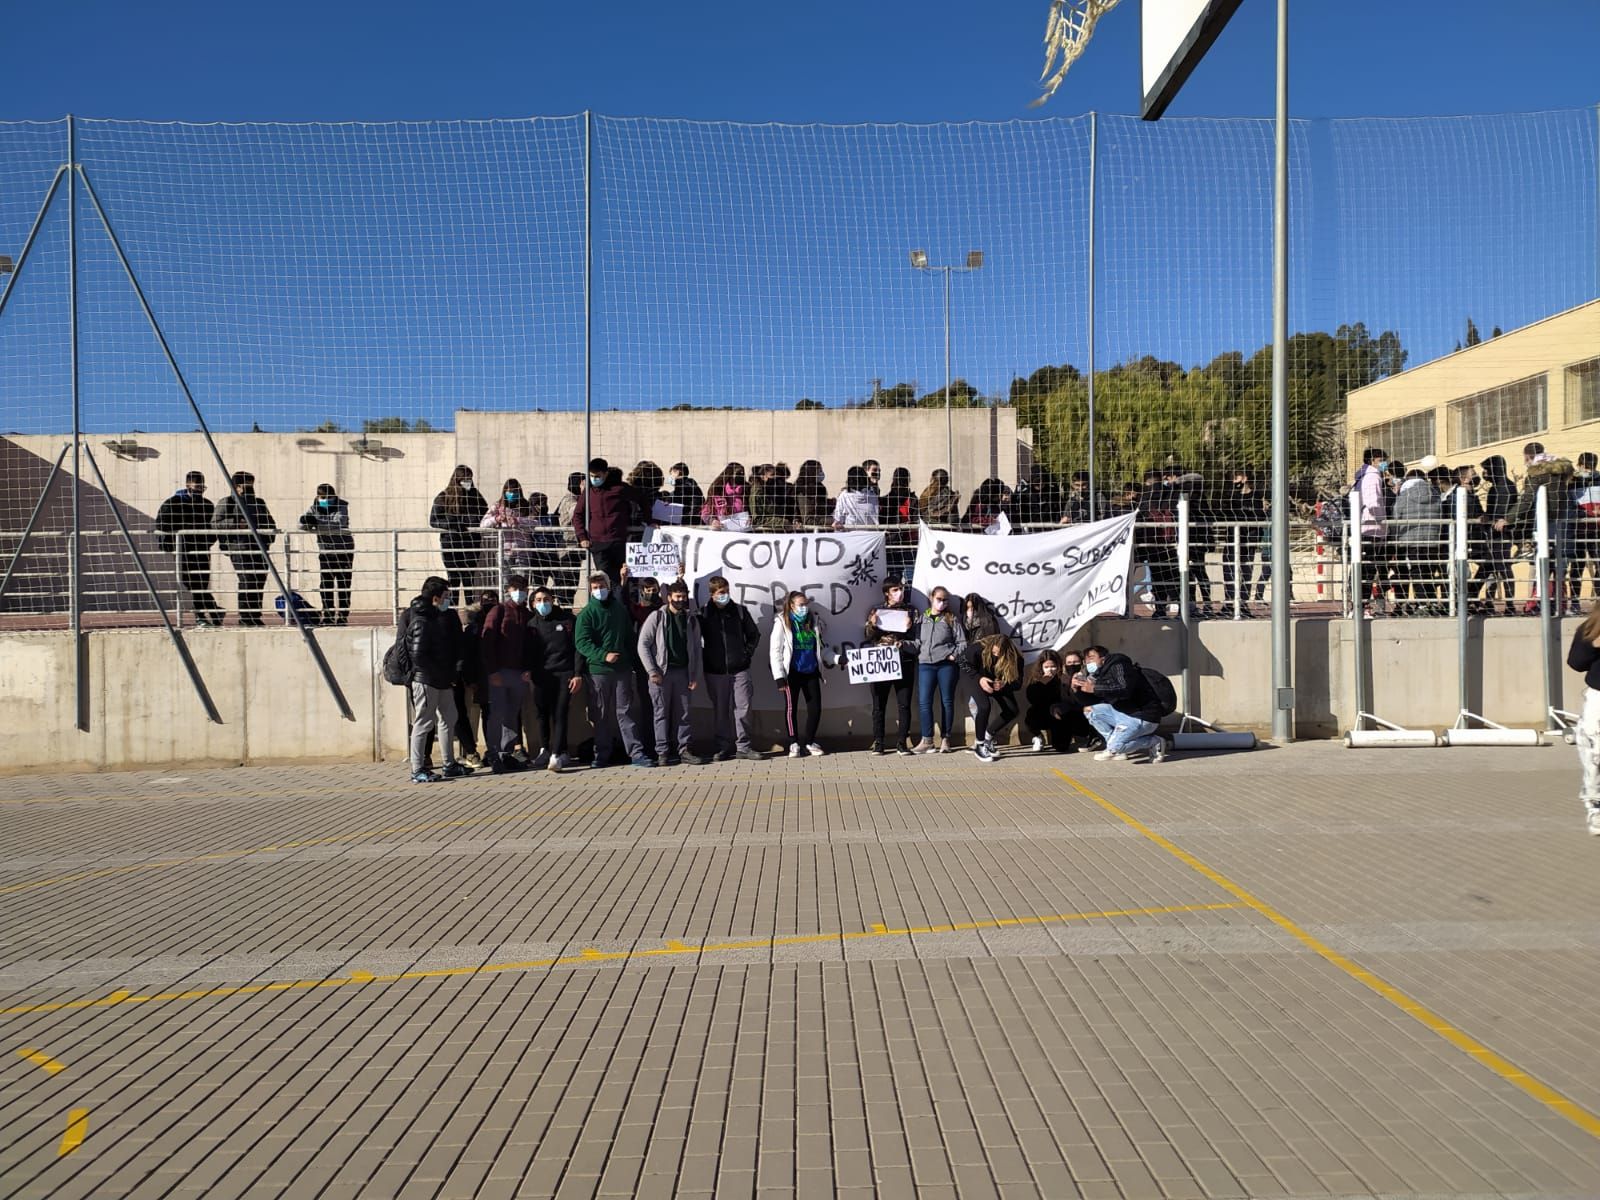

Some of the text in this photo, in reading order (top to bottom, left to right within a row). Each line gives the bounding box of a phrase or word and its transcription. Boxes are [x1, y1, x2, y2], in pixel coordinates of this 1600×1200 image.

[629, 543, 674, 554] NI COVID
[721, 537, 846, 570] COVID
[635, 555, 648, 565] NI
[931, 540, 970, 571] Los
[985, 561, 1056, 576] casos
[851, 650, 862, 661] NI
[867, 647, 893, 661] FRIO
[851, 660, 900, 677] NI COVID
